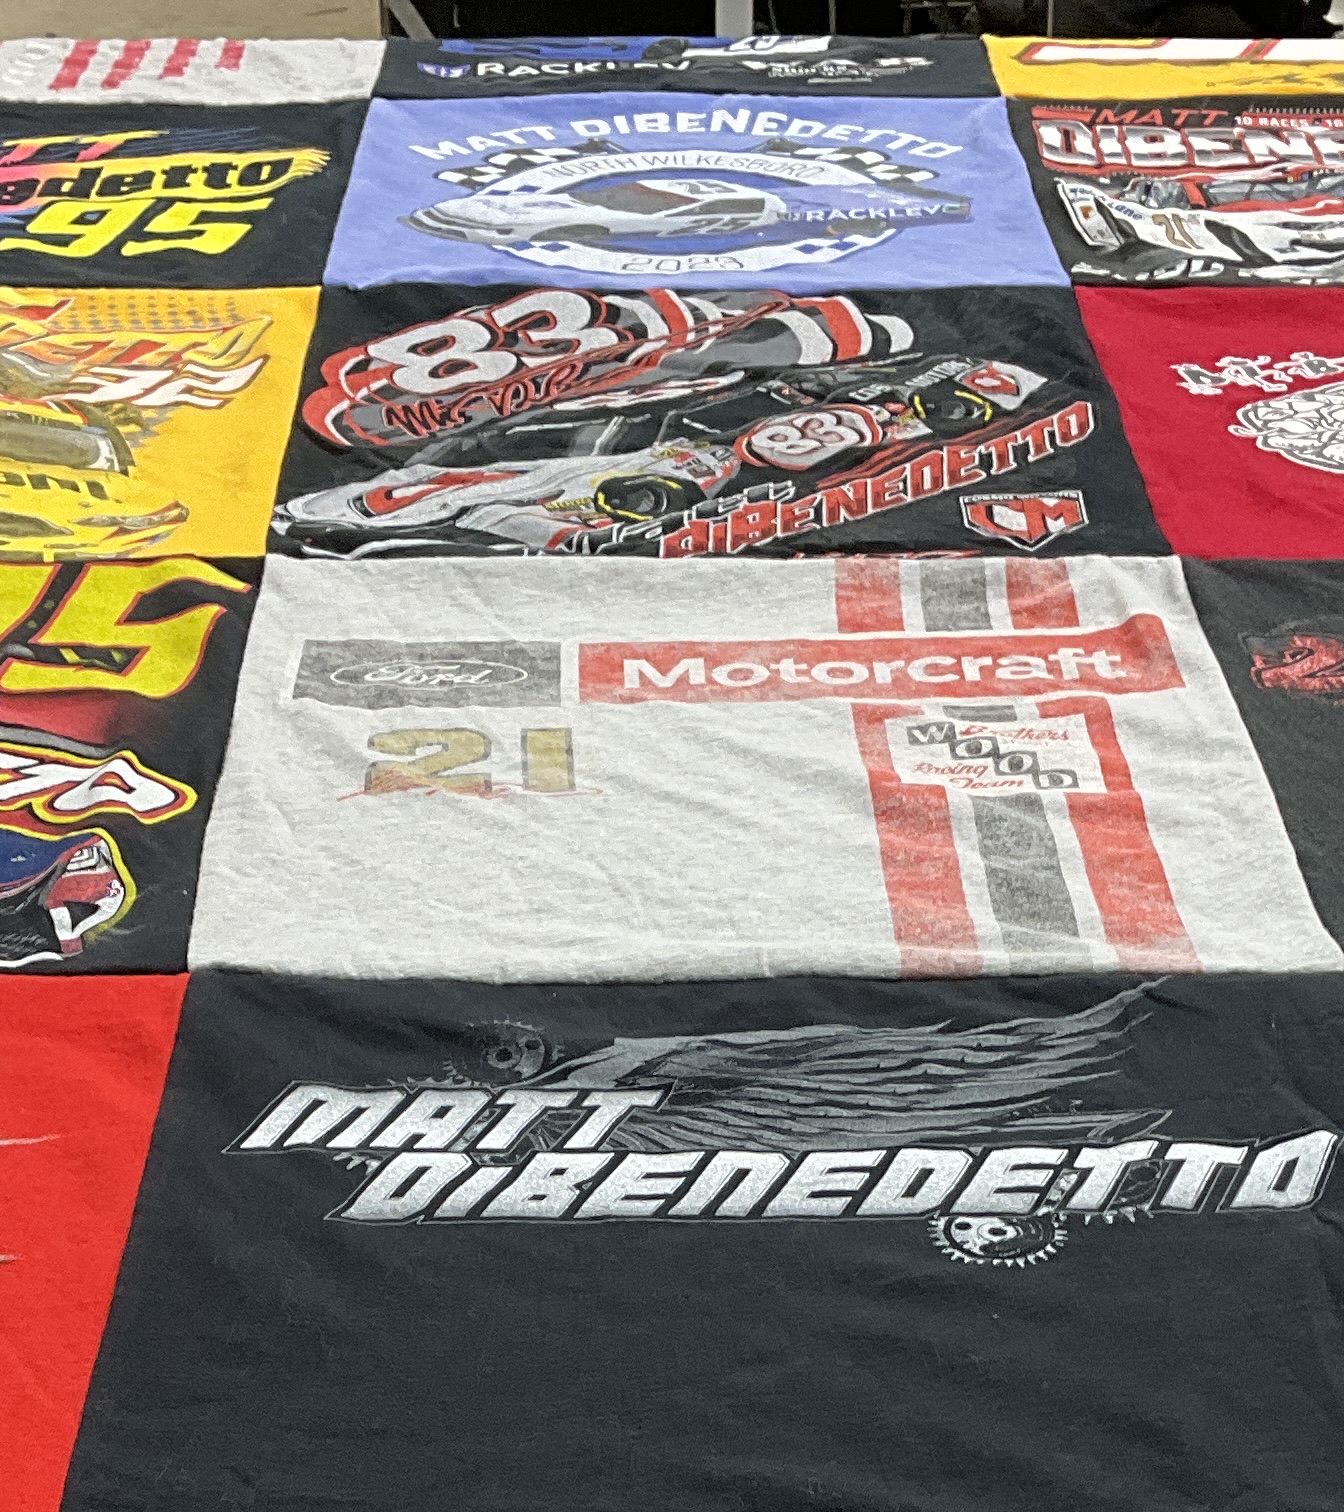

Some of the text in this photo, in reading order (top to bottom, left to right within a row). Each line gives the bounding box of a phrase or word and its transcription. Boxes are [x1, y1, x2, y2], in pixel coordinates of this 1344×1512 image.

[408, 108, 964, 160] MATT DIBENEDETTO
[1097, 109, 1229, 126] MATT
[621, 255, 745, 272] 2023
[364, 288, 626, 395] 83
[751, 408, 849, 455] 83
[363, 663, 494, 687] Ford
[623, 645, 1131, 690] Motorcraft
[364, 726, 576, 794] 21
[246, 1085, 666, 1153] MATT
